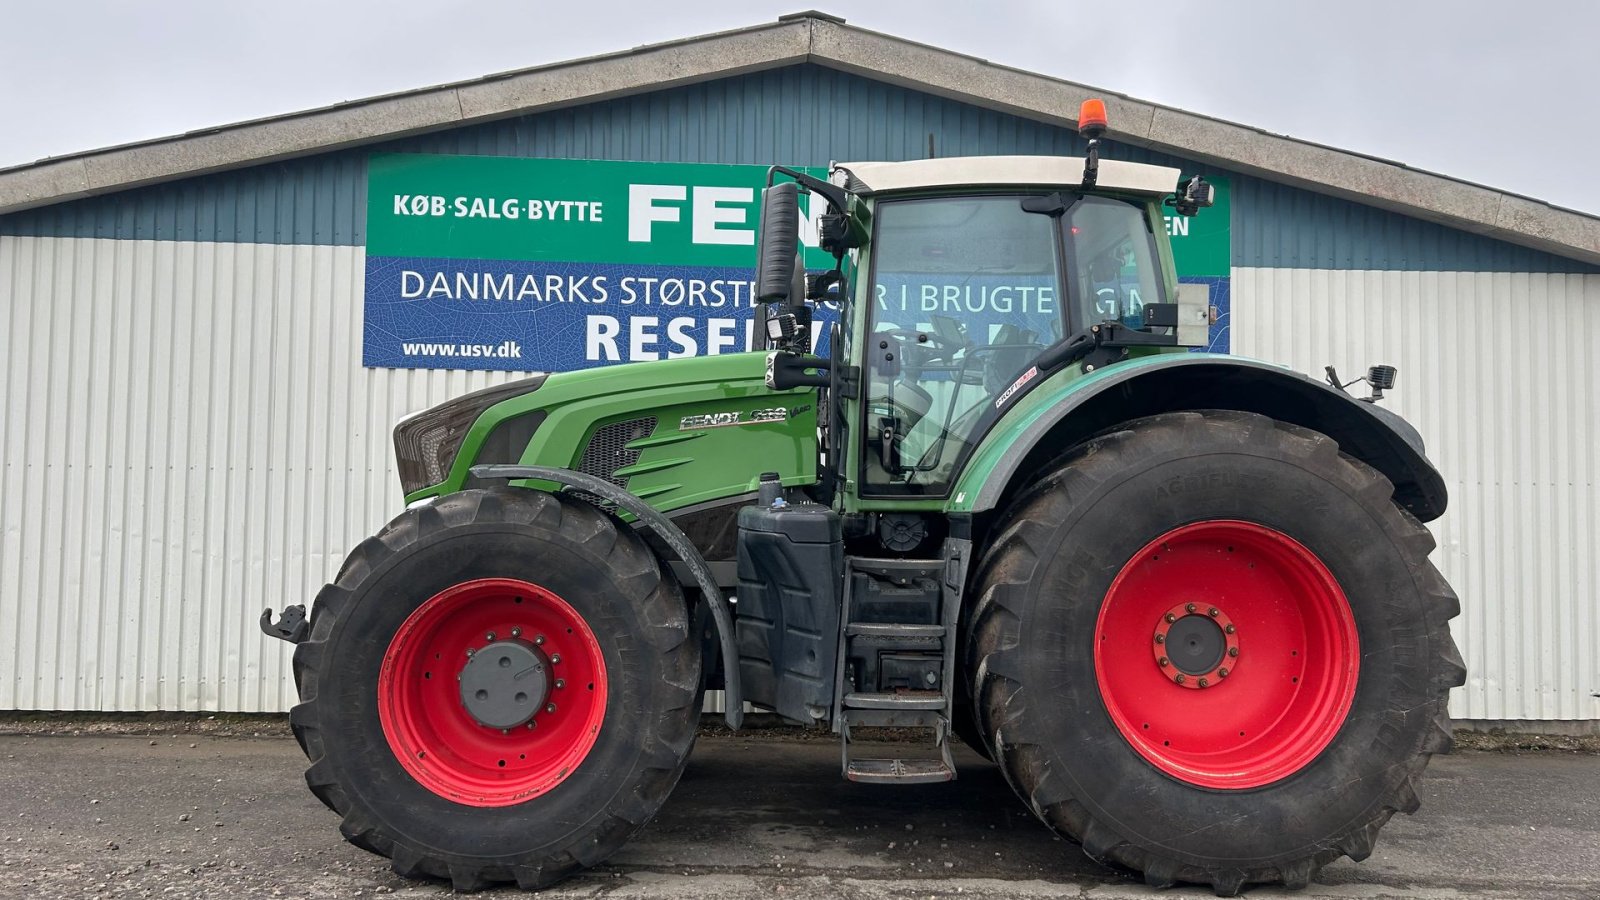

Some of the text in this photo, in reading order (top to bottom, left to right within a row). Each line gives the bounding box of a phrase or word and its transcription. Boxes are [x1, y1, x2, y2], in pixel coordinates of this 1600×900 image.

[401, 270, 608, 304] DANMARKS
[921, 285, 1053, 313] BRUGTE
[402, 341, 521, 358] www.usv.dk
